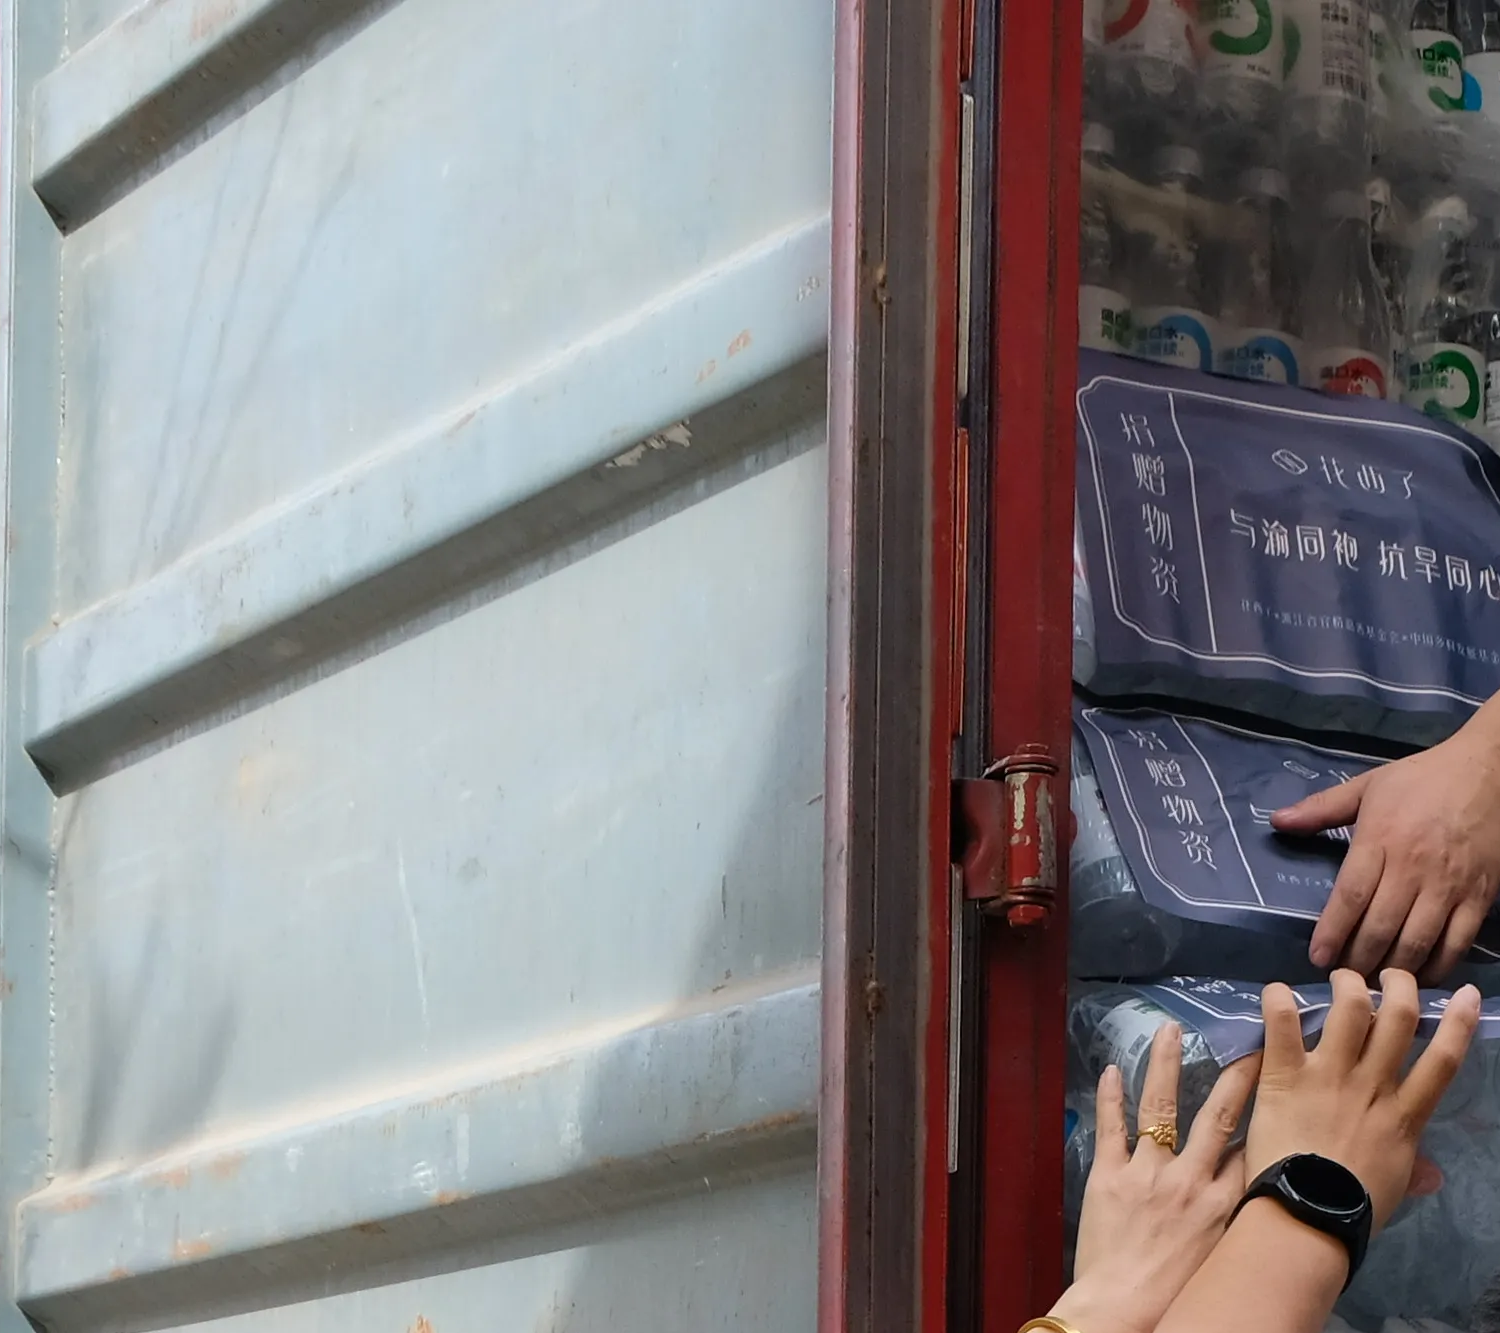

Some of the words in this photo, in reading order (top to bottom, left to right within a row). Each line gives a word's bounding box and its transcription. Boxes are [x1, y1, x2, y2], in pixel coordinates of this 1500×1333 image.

[1119, 411, 1182, 605] 捐赠物资
[1228, 507, 1361, 574] 与渝同袍
